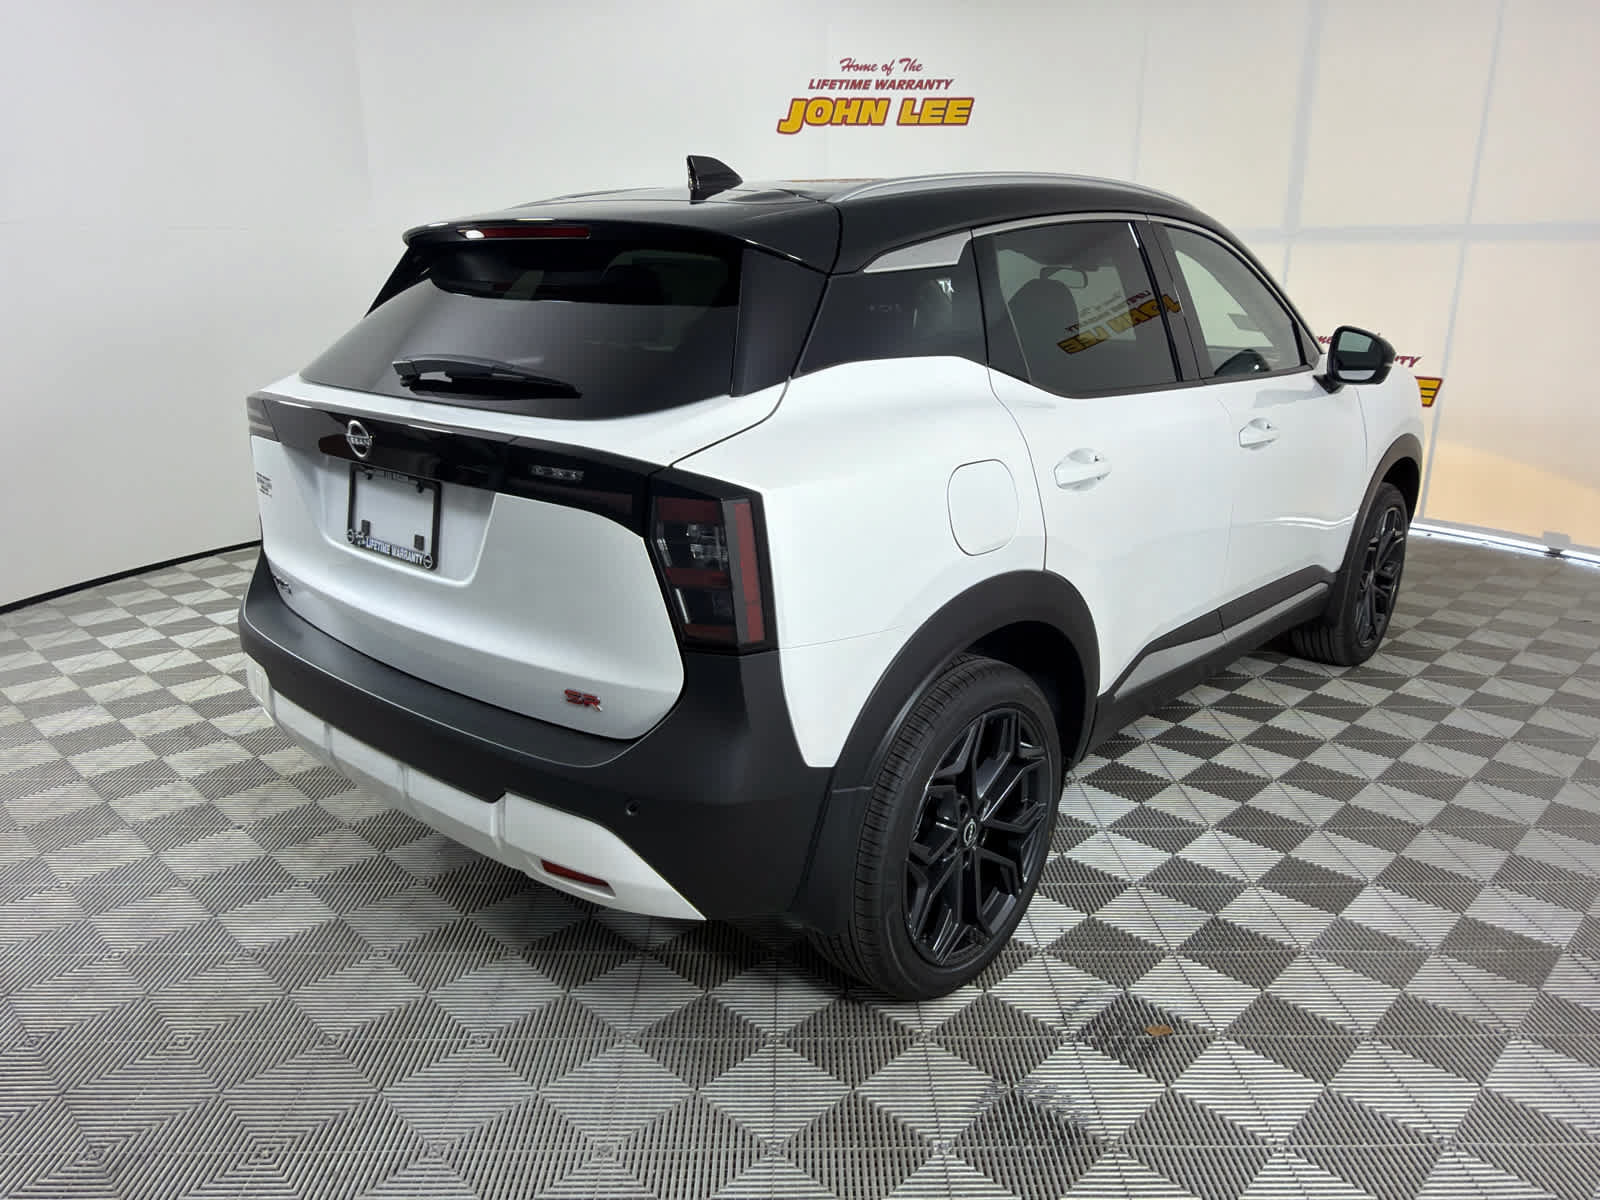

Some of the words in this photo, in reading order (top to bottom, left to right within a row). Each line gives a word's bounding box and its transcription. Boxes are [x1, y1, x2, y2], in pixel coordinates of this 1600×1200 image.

[839, 57, 878, 72] Home
[881, 59, 895, 76] of
[898, 57, 923, 72] The
[808, 79, 871, 90] LIFETIME
[874, 79, 954, 90] WARRANTY
[777, 97, 891, 135] JOHN
[896, 97, 975, 126] LEE
[366, 537, 390, 554] LIFETIME
[391, 545, 423, 565] WARRANTY
